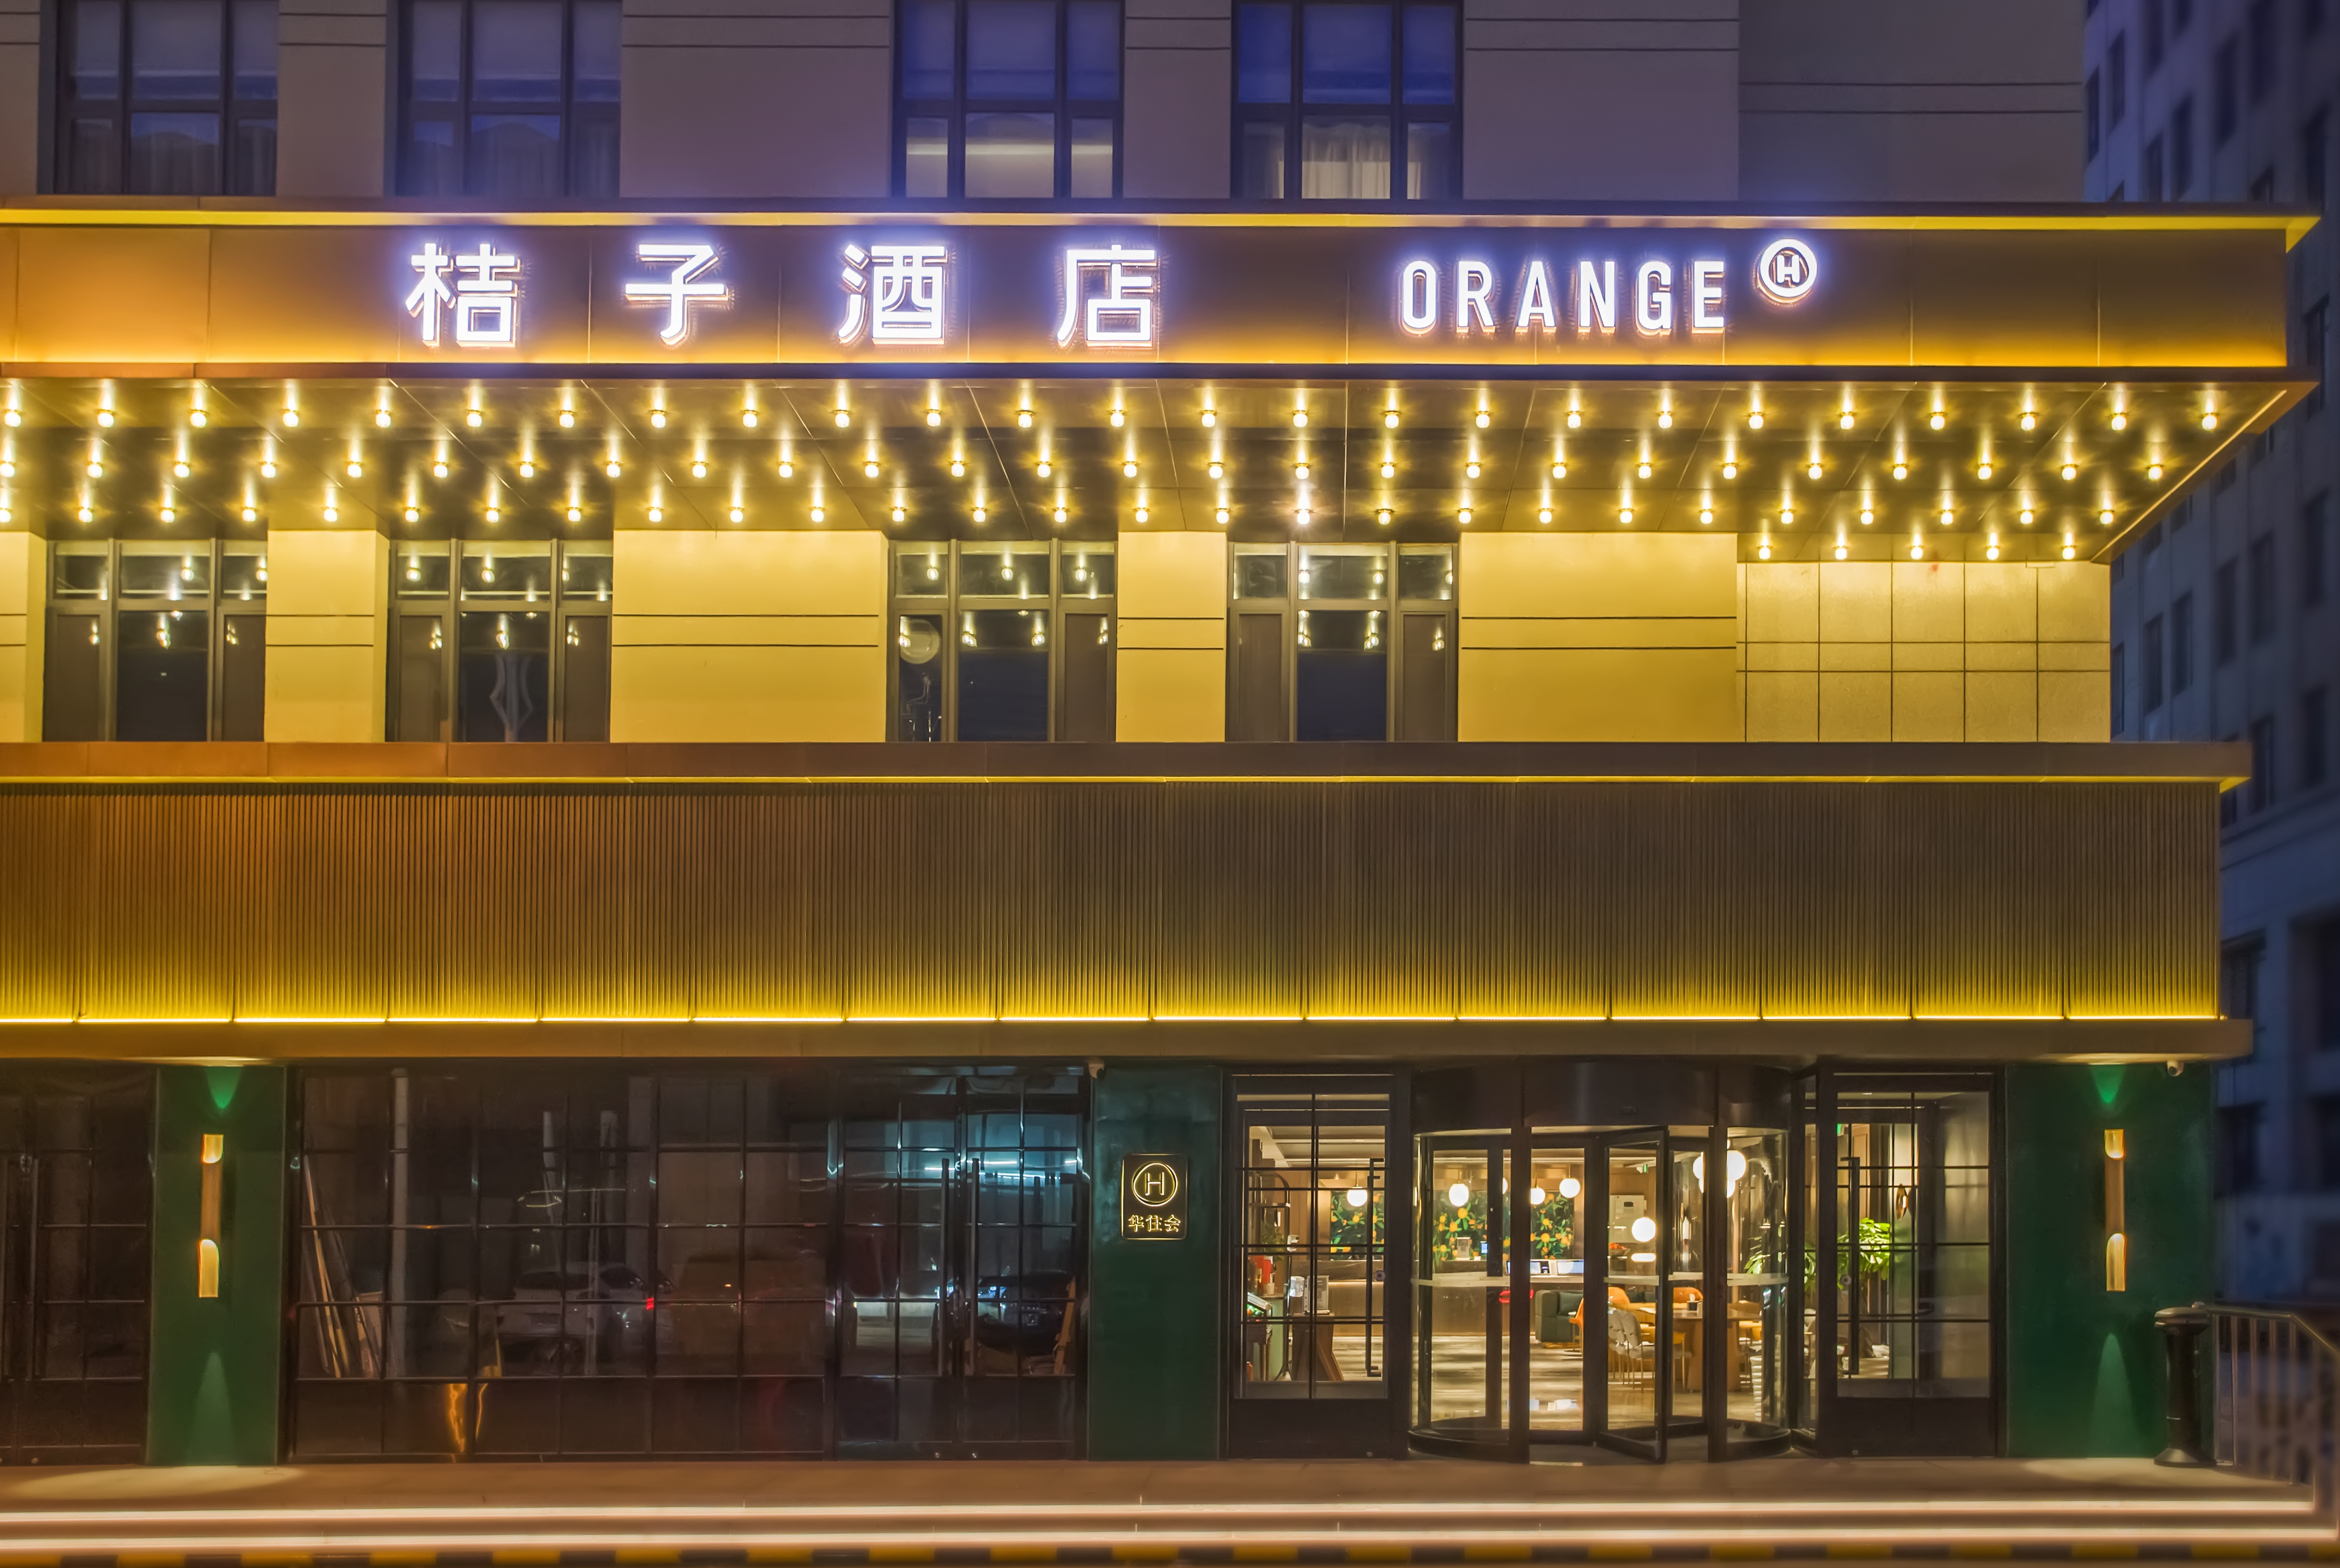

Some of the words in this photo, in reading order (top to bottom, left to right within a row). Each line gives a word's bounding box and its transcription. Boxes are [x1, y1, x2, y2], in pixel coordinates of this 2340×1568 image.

[405, 242, 1157, 346] 桔子酒店
[1402, 260, 1725, 332] ORANGE
[1128, 1214, 1181, 1233] 华住会
